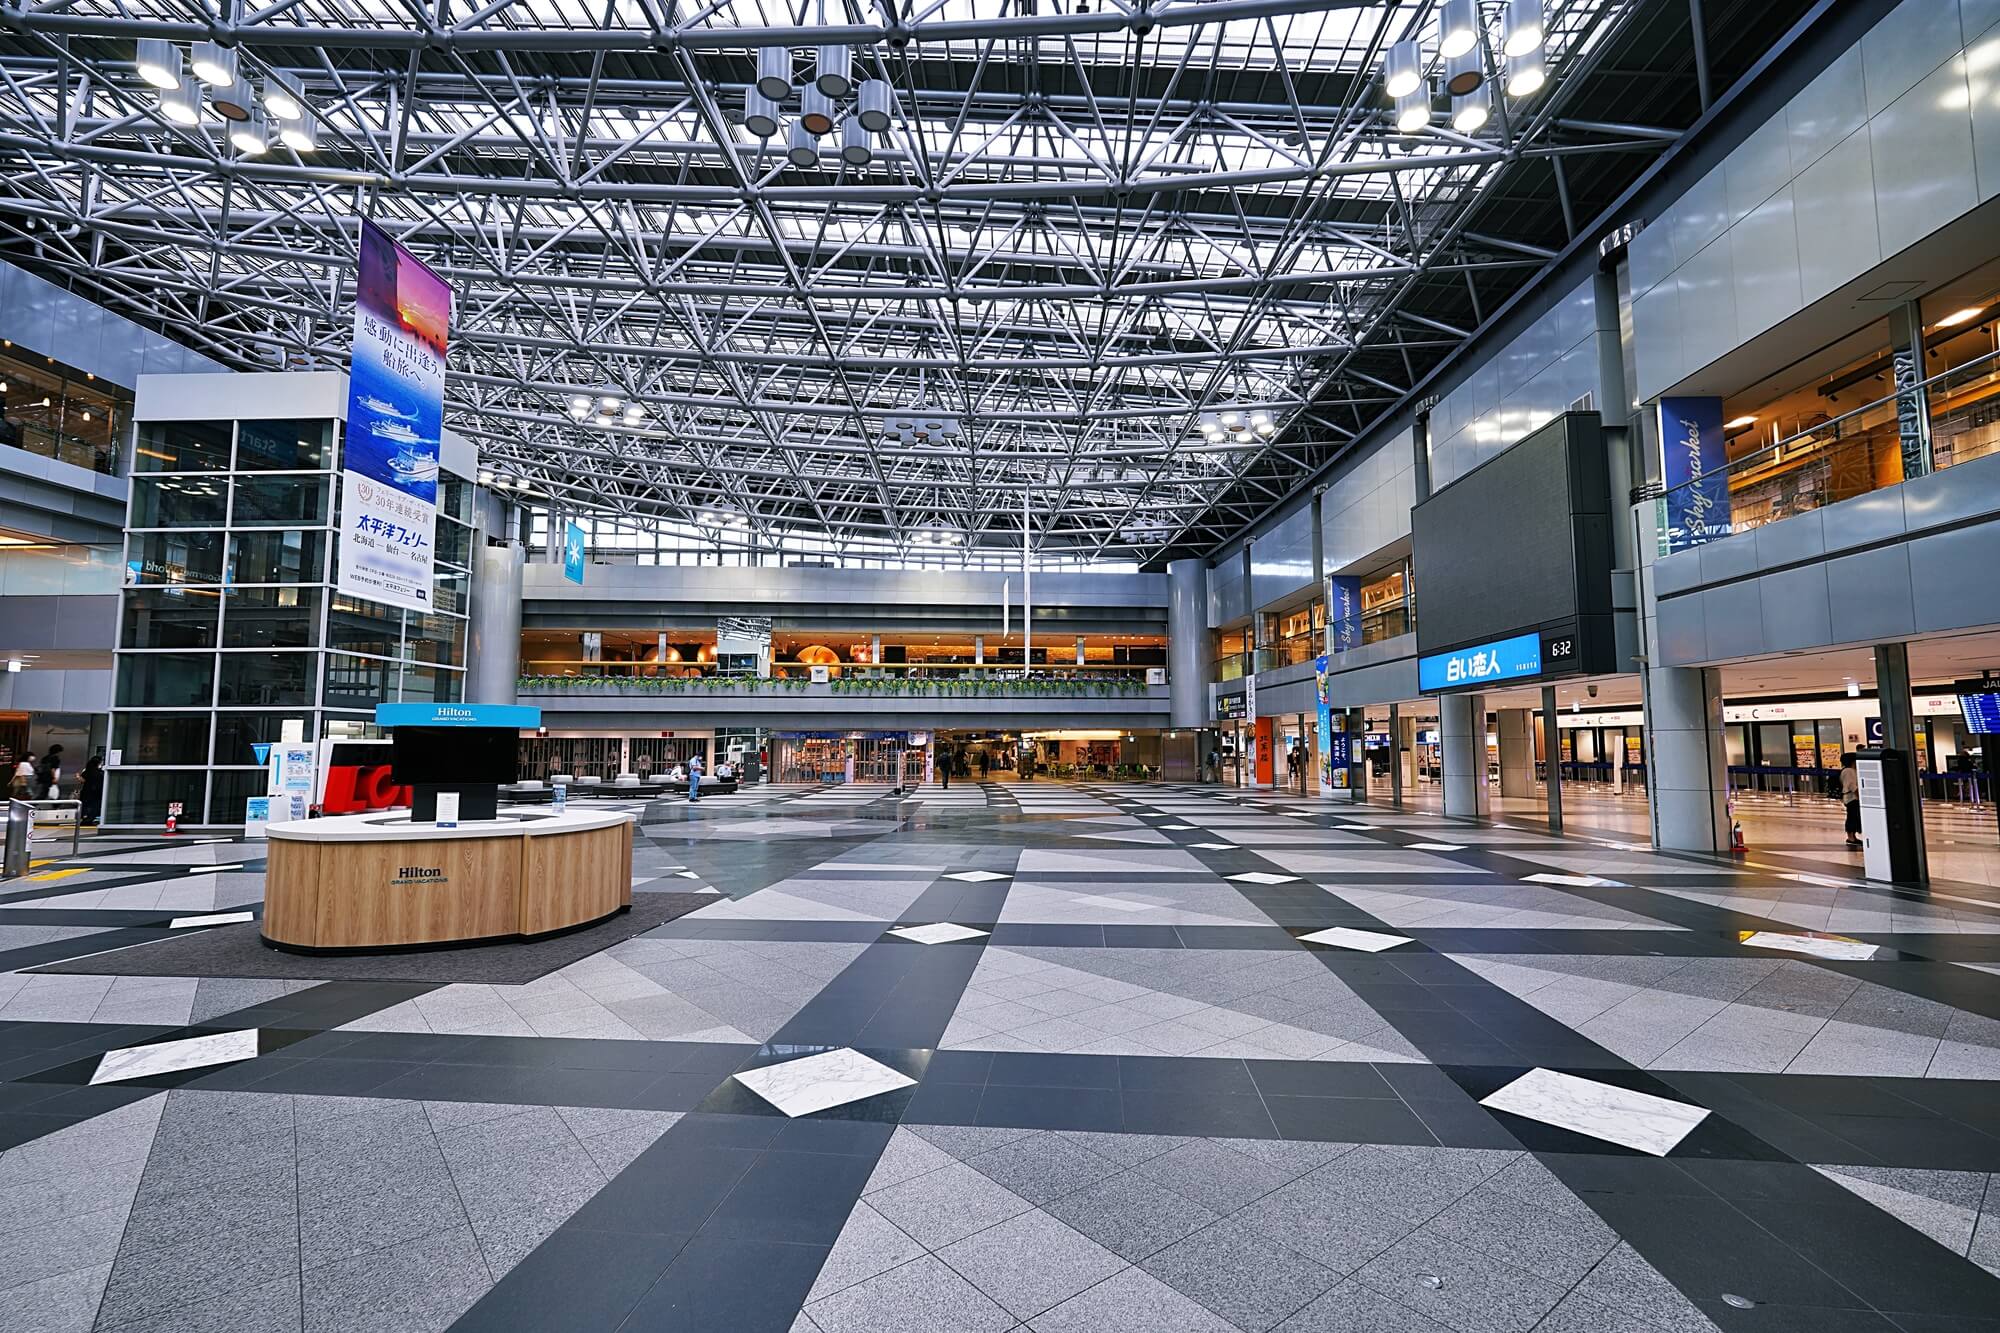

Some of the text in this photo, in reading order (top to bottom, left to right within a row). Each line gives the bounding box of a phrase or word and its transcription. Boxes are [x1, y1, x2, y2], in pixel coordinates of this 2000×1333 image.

[364, 316, 441, 378] 感動に出逢う、
[382, 348, 426, 389] 船旅へ。
[356, 514, 429, 548] 太平洋フェリー
[1552, 640, 1571, 657] 6:32
[1446, 649, 1501, 682] 白い恋人
[437, 707, 472, 717] Hilton
[398, 866, 441, 879] Hilton
